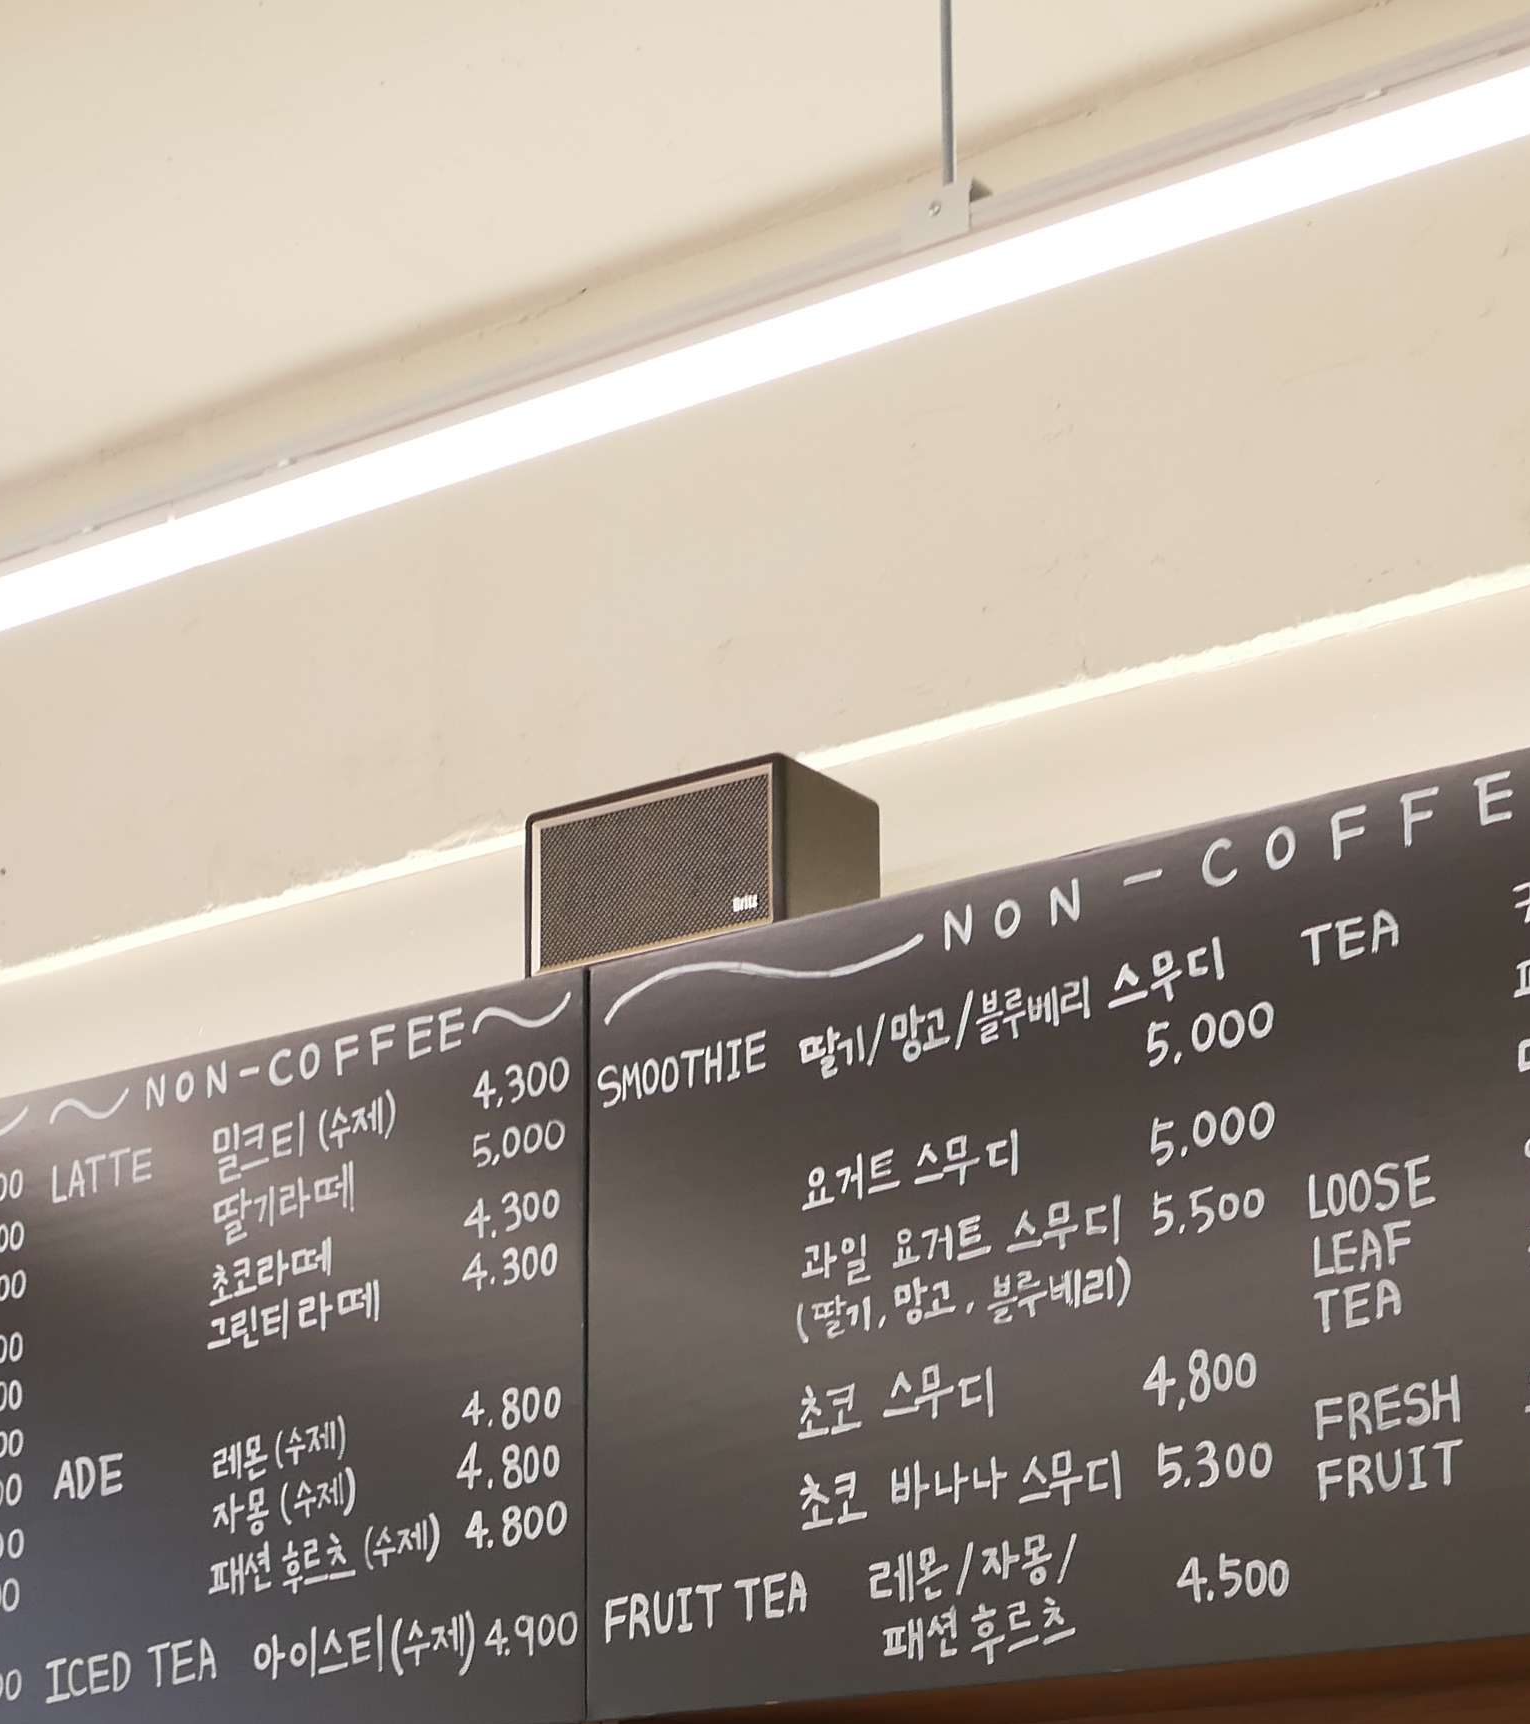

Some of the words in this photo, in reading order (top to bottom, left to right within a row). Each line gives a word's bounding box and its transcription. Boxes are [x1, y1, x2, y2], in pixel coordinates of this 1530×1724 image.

[1301, 909, 1399, 966] TEA
[597, 1030, 766, 1108] SMOOTHIE
[1108, 936, 1224, 1009] 스무디
[52, 1148, 151, 1203] LATTE
[213, 1111, 304, 1184] 밀크티
[319, 1089, 396, 1152] (수제)
[473, 1056, 569, 1109] 4,300
[213, 1154, 354, 1246] 딸기라떼
[473, 1120, 565, 1167] 5,000
[802, 1149, 901, 1211] 요거트
[914, 1128, 1018, 1186] 스무디
[1309, 1155, 1436, 1219] LOOSE
[209, 1237, 331, 1306] 초코라떼
[802, 1234, 871, 1286] 과일
[893, 1215, 991, 1268] 요거트
[1006, 1194, 1121, 1253] 스무디
[1314, 1220, 1411, 1277] LEAF
[1314, 1279, 1401, 1333] TEA
[798, 1383, 862, 1440] 초코
[883, 1364, 993, 1419] 스무디
[1143, 1349, 1256, 1411] 4,800
[1315, 1374, 1460, 1440] FRESH
[53, 1453, 123, 1500] ADE
[213, 1487, 269, 1536] 자몽
[281, 1467, 355, 1525] (수제)
[800, 1471, 867, 1530] 초코
[891, 1456, 1007, 1510] 바나나
[1018, 1450, 1121, 1506] 스무디
[1317, 1439, 1463, 1502] FRUIT
[208, 1541, 272, 1595] 패션
[282, 1533, 356, 1594] 후르츠
[365, 1512, 440, 1570] (수제)
[605, 1583, 722, 1644] FRUIT
[734, 1571, 807, 1622] TEA
[46, 1651, 131, 1704] ICED
[147, 1638, 216, 1687] TEA
